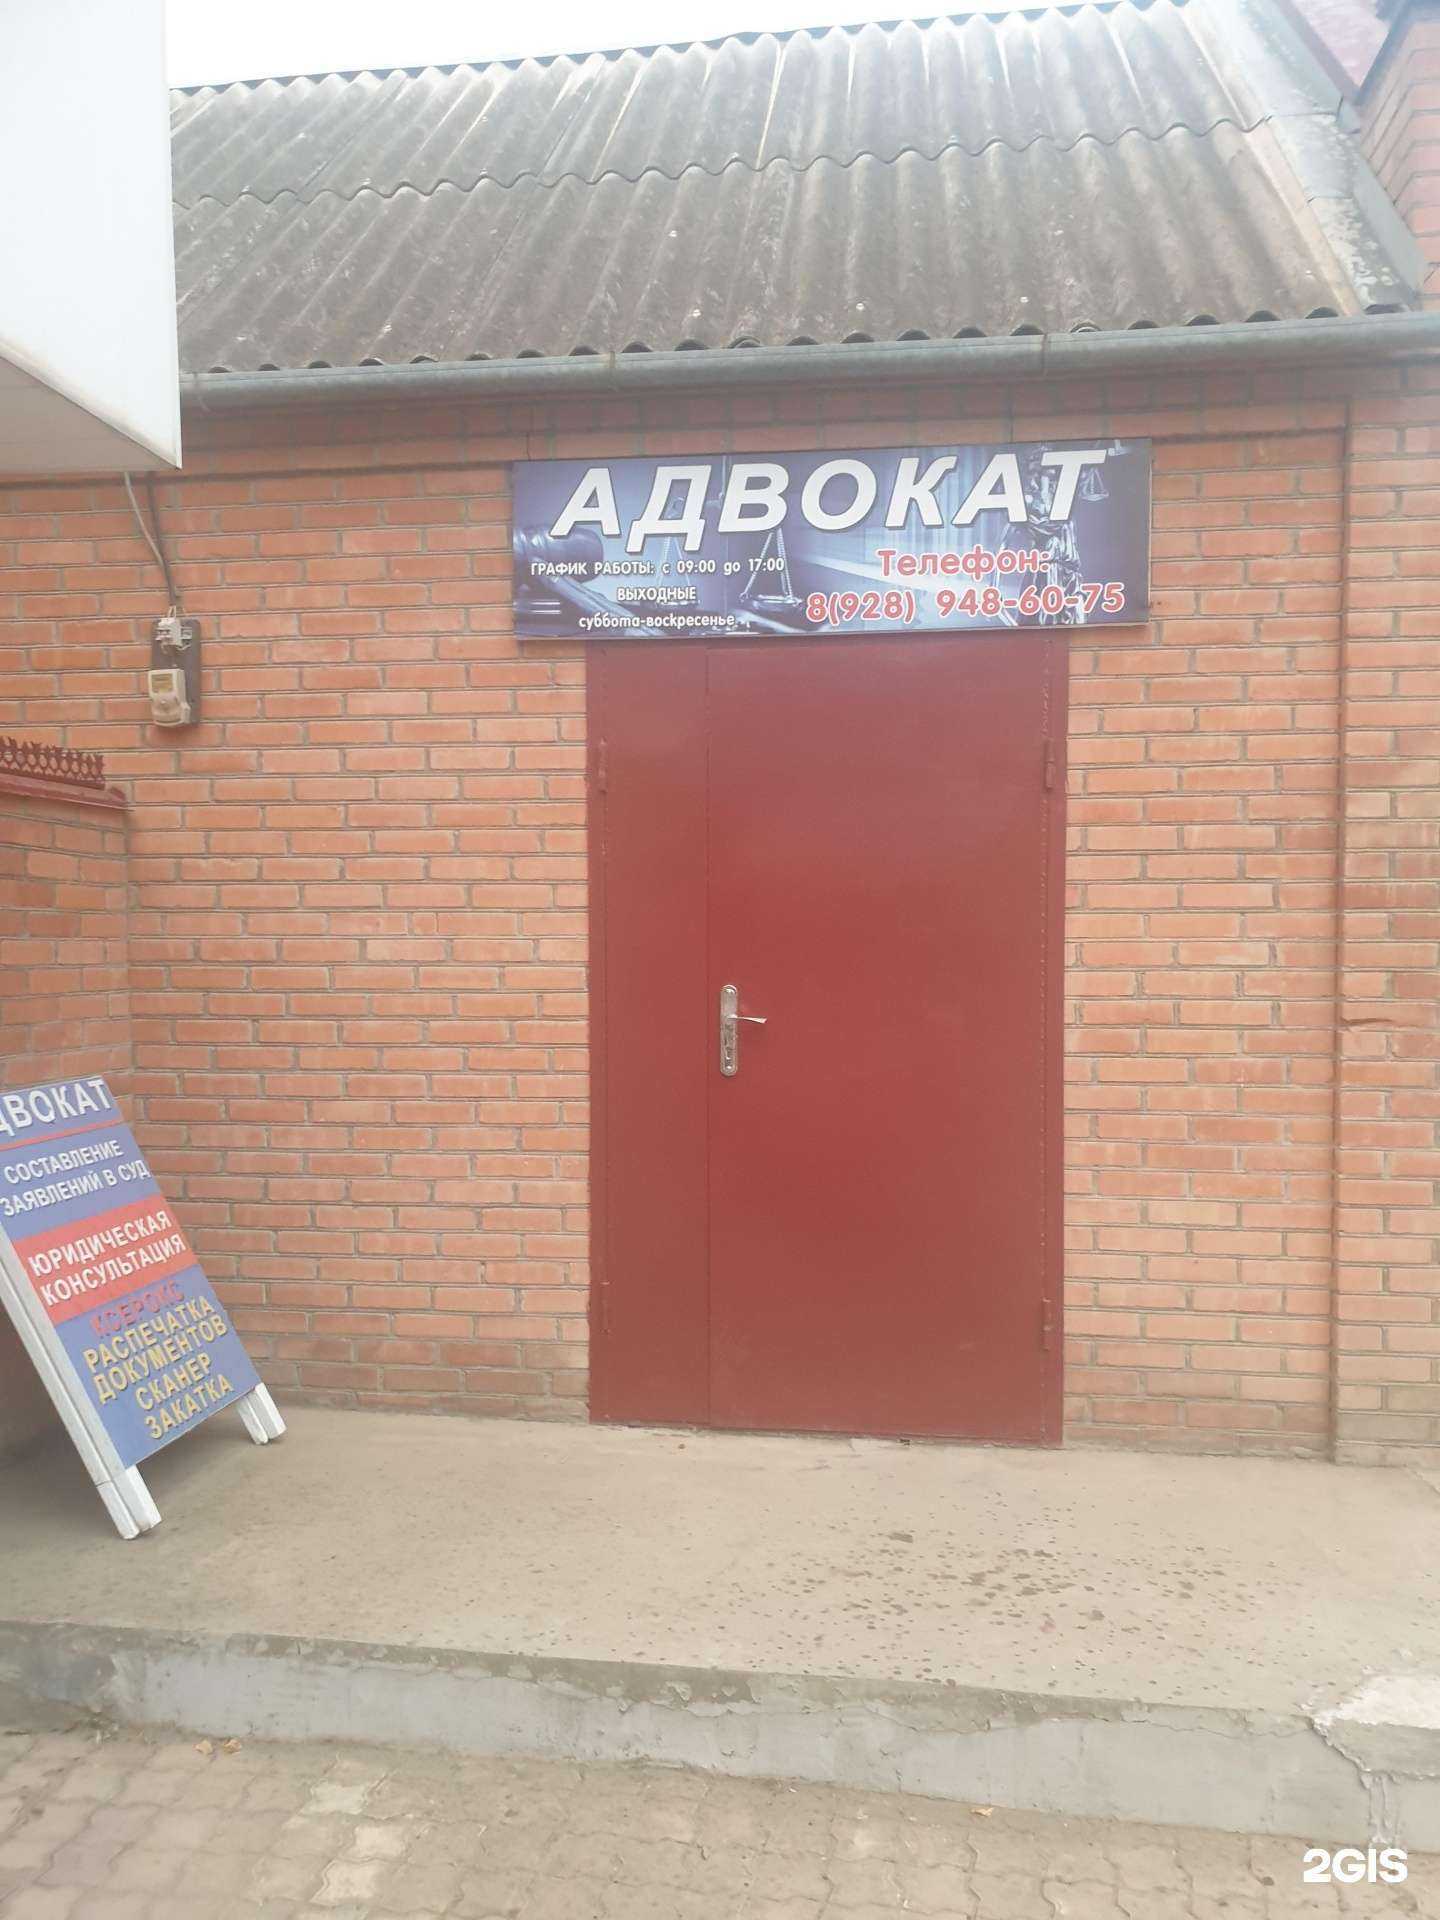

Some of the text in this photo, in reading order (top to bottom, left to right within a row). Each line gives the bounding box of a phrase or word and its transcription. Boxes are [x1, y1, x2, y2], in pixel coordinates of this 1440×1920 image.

[549, 449, 1107, 552] АДВОКАТ
[530, 561, 588, 576] ГРАФИК
[594, 560, 656, 575] РАБОТЫ:
[662, 564, 670, 573] с
[677, 559, 716, 573] 09:00
[749, 557, 785, 572] 17:00
[876, 544, 1051, 581] Телефон:
[578, 611, 736, 629] суббота-воскресенье
[617, 586, 697, 605] ВЫХОДНЫЕ
[805, 582, 1125, 626] 8(928) 948-60-75
[0, 1159, 151, 1217] ЗАЯВЛЕНИЙ В СУД
[3, 1140, 124, 1184] СОСТАВЛЕНИЕ
[27, 1210, 172, 1277] ЮРИДИЧЕСКАЯ
[40, 1233, 186, 1306] КОНСУЛЬТАЦИЯ
[83, 1295, 215, 1373] РАСПЕЧАТКА
[93, 1314, 228, 1404] ДОКУМЕНТОВ
[135, 1352, 212, 1411] СКАНЕР
[144, 1373, 234, 1440] ЗАКАТКА
